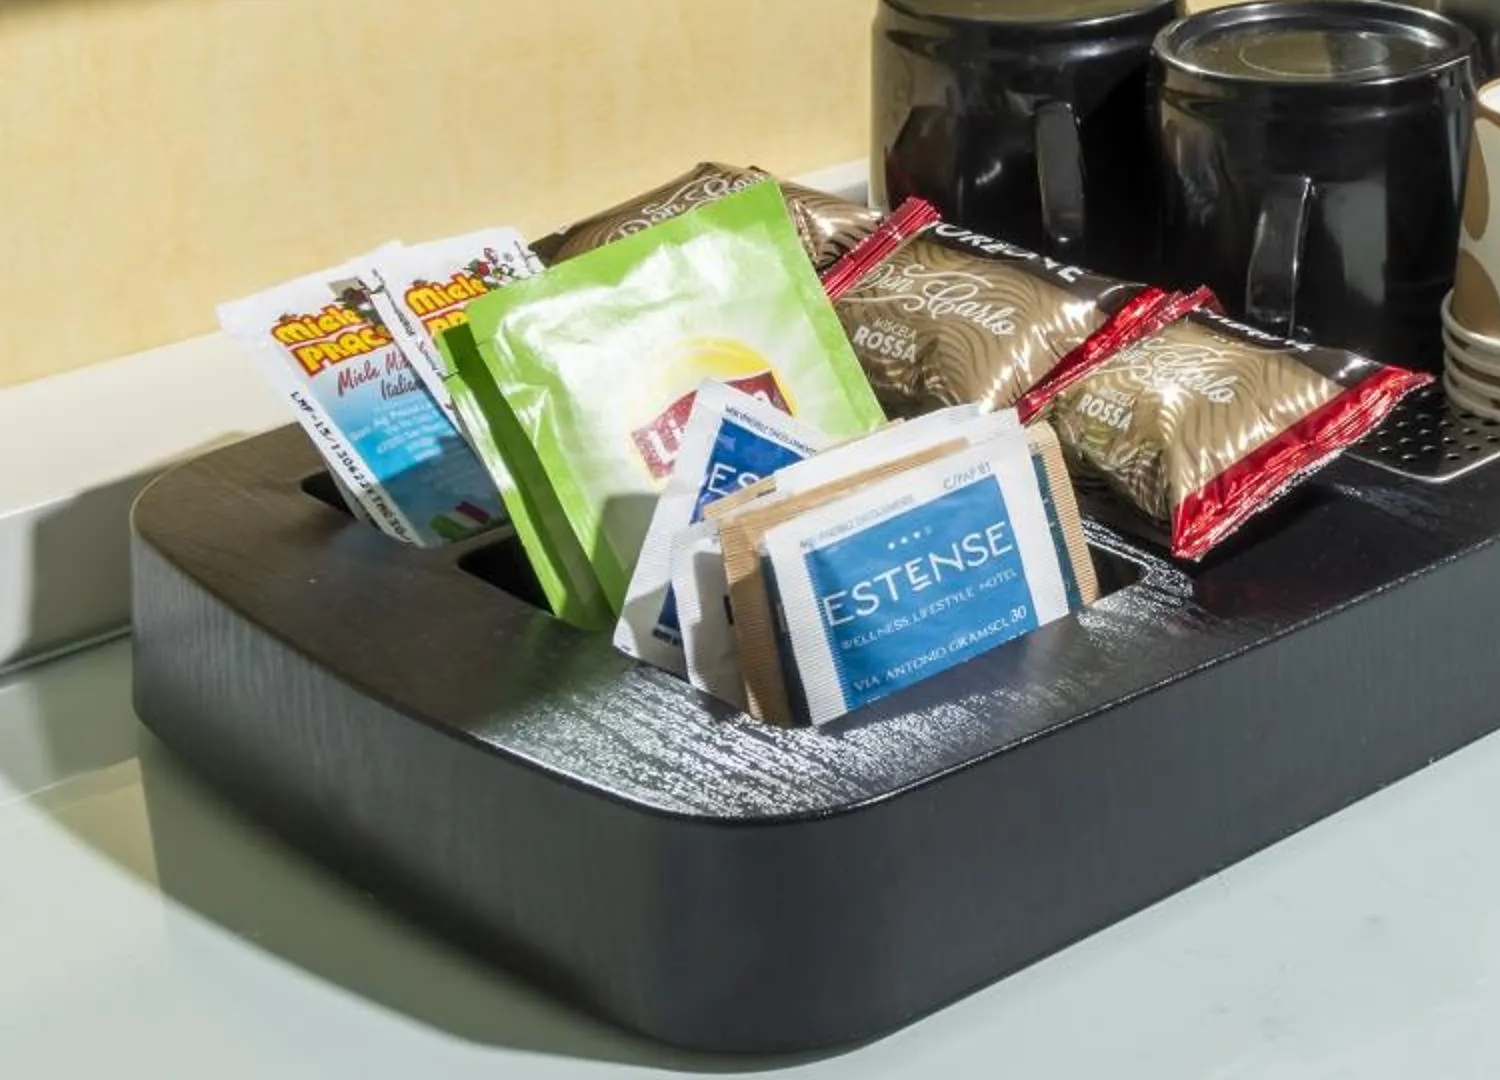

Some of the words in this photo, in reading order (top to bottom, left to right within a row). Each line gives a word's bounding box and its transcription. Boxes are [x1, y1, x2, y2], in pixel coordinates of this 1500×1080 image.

[922, 281, 1017, 336] Carlo
[852, 325, 918, 364] ROSSA
[1076, 393, 1134, 432] ROSSA
[822, 521, 1014, 628] ESTENSE
[979, 569, 1018, 592] HOTEL
[853, 677, 881, 691] VIA
[885, 646, 947, 680] ANTONIO
[1011, 604, 1027, 620] 30
